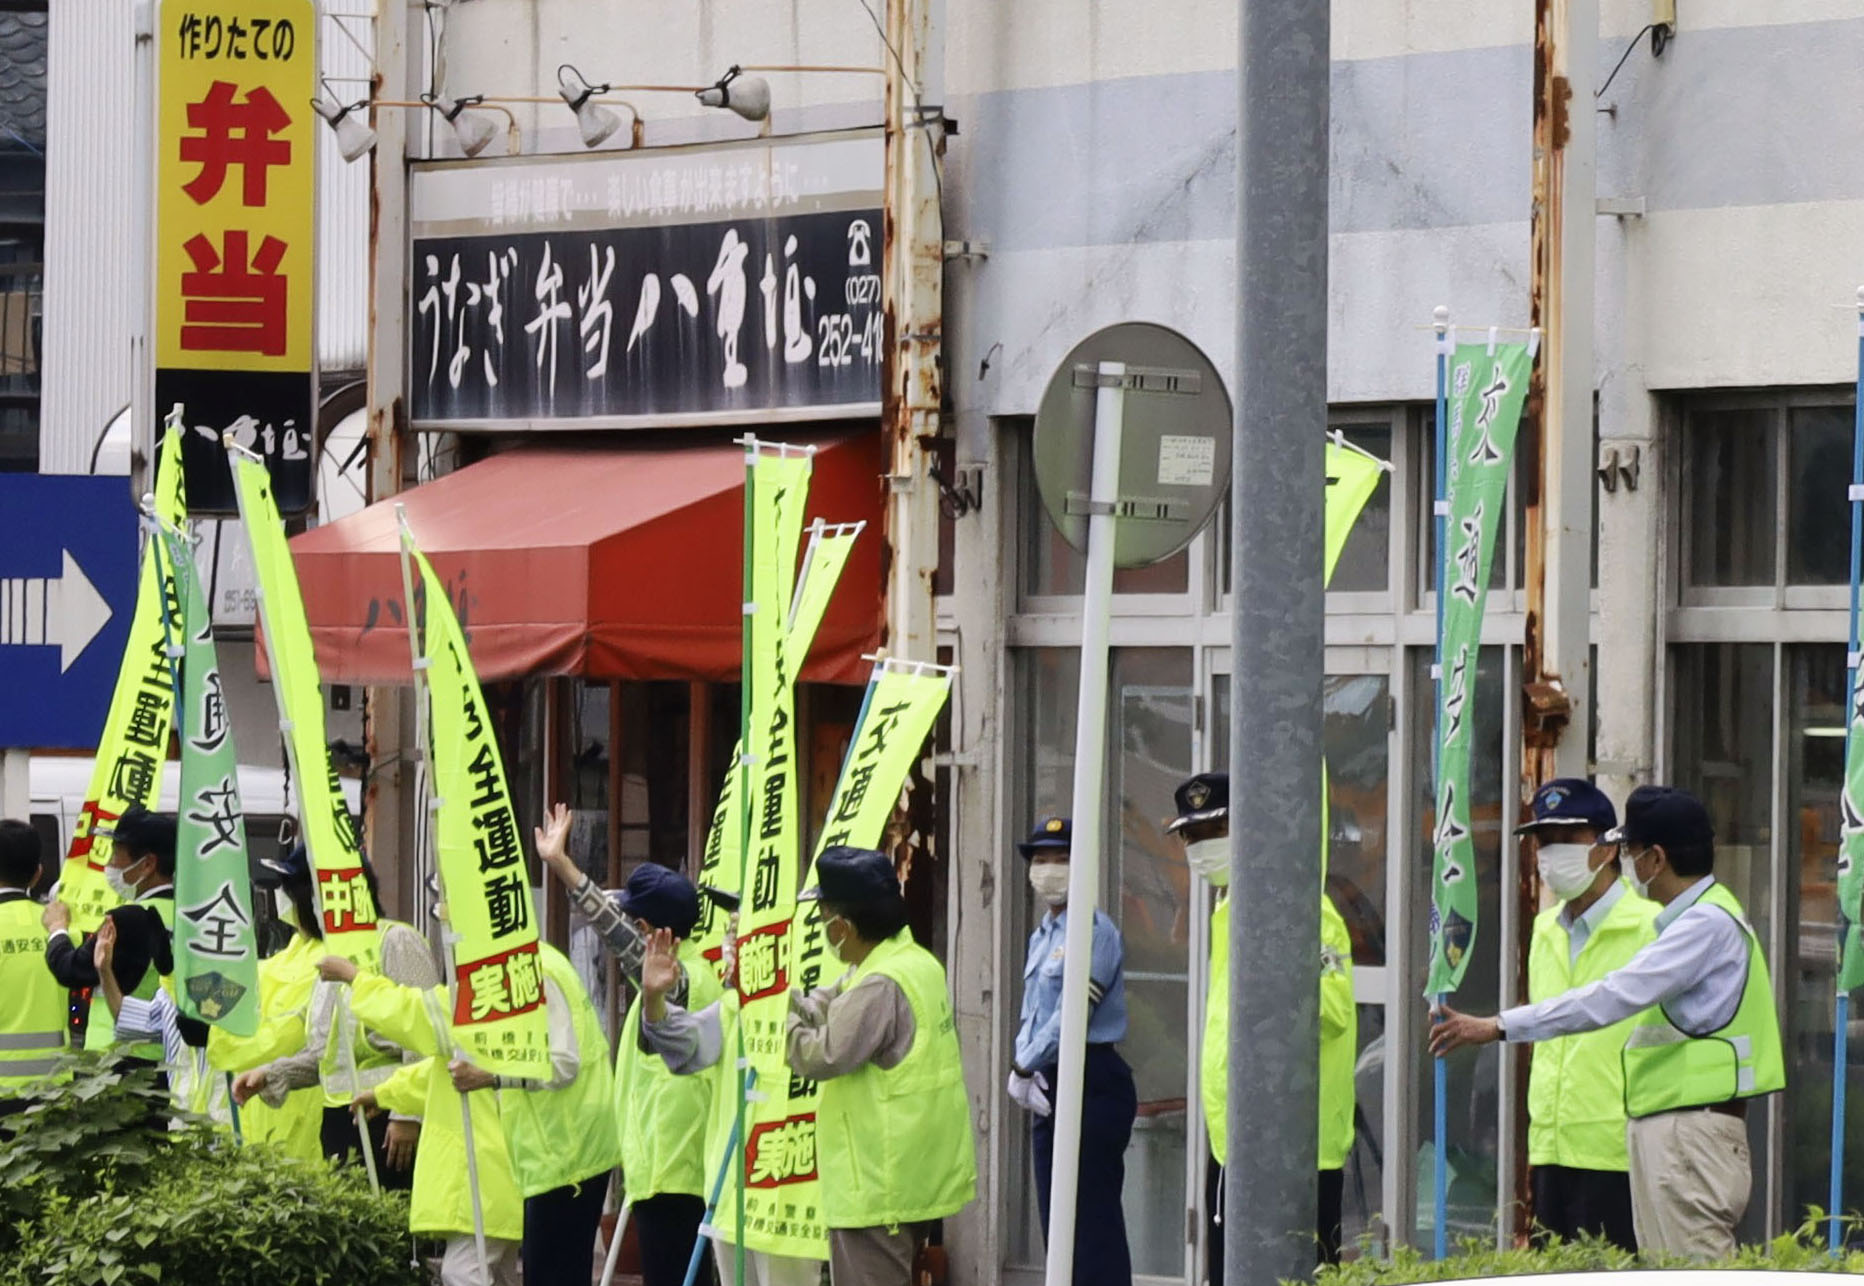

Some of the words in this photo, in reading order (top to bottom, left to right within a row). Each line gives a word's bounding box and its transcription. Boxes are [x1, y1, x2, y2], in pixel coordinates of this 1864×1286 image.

[179, 14, 294, 61] 作りたての
[179, 80, 293, 357] 弁当
[845, 275, 881, 305] (027)
